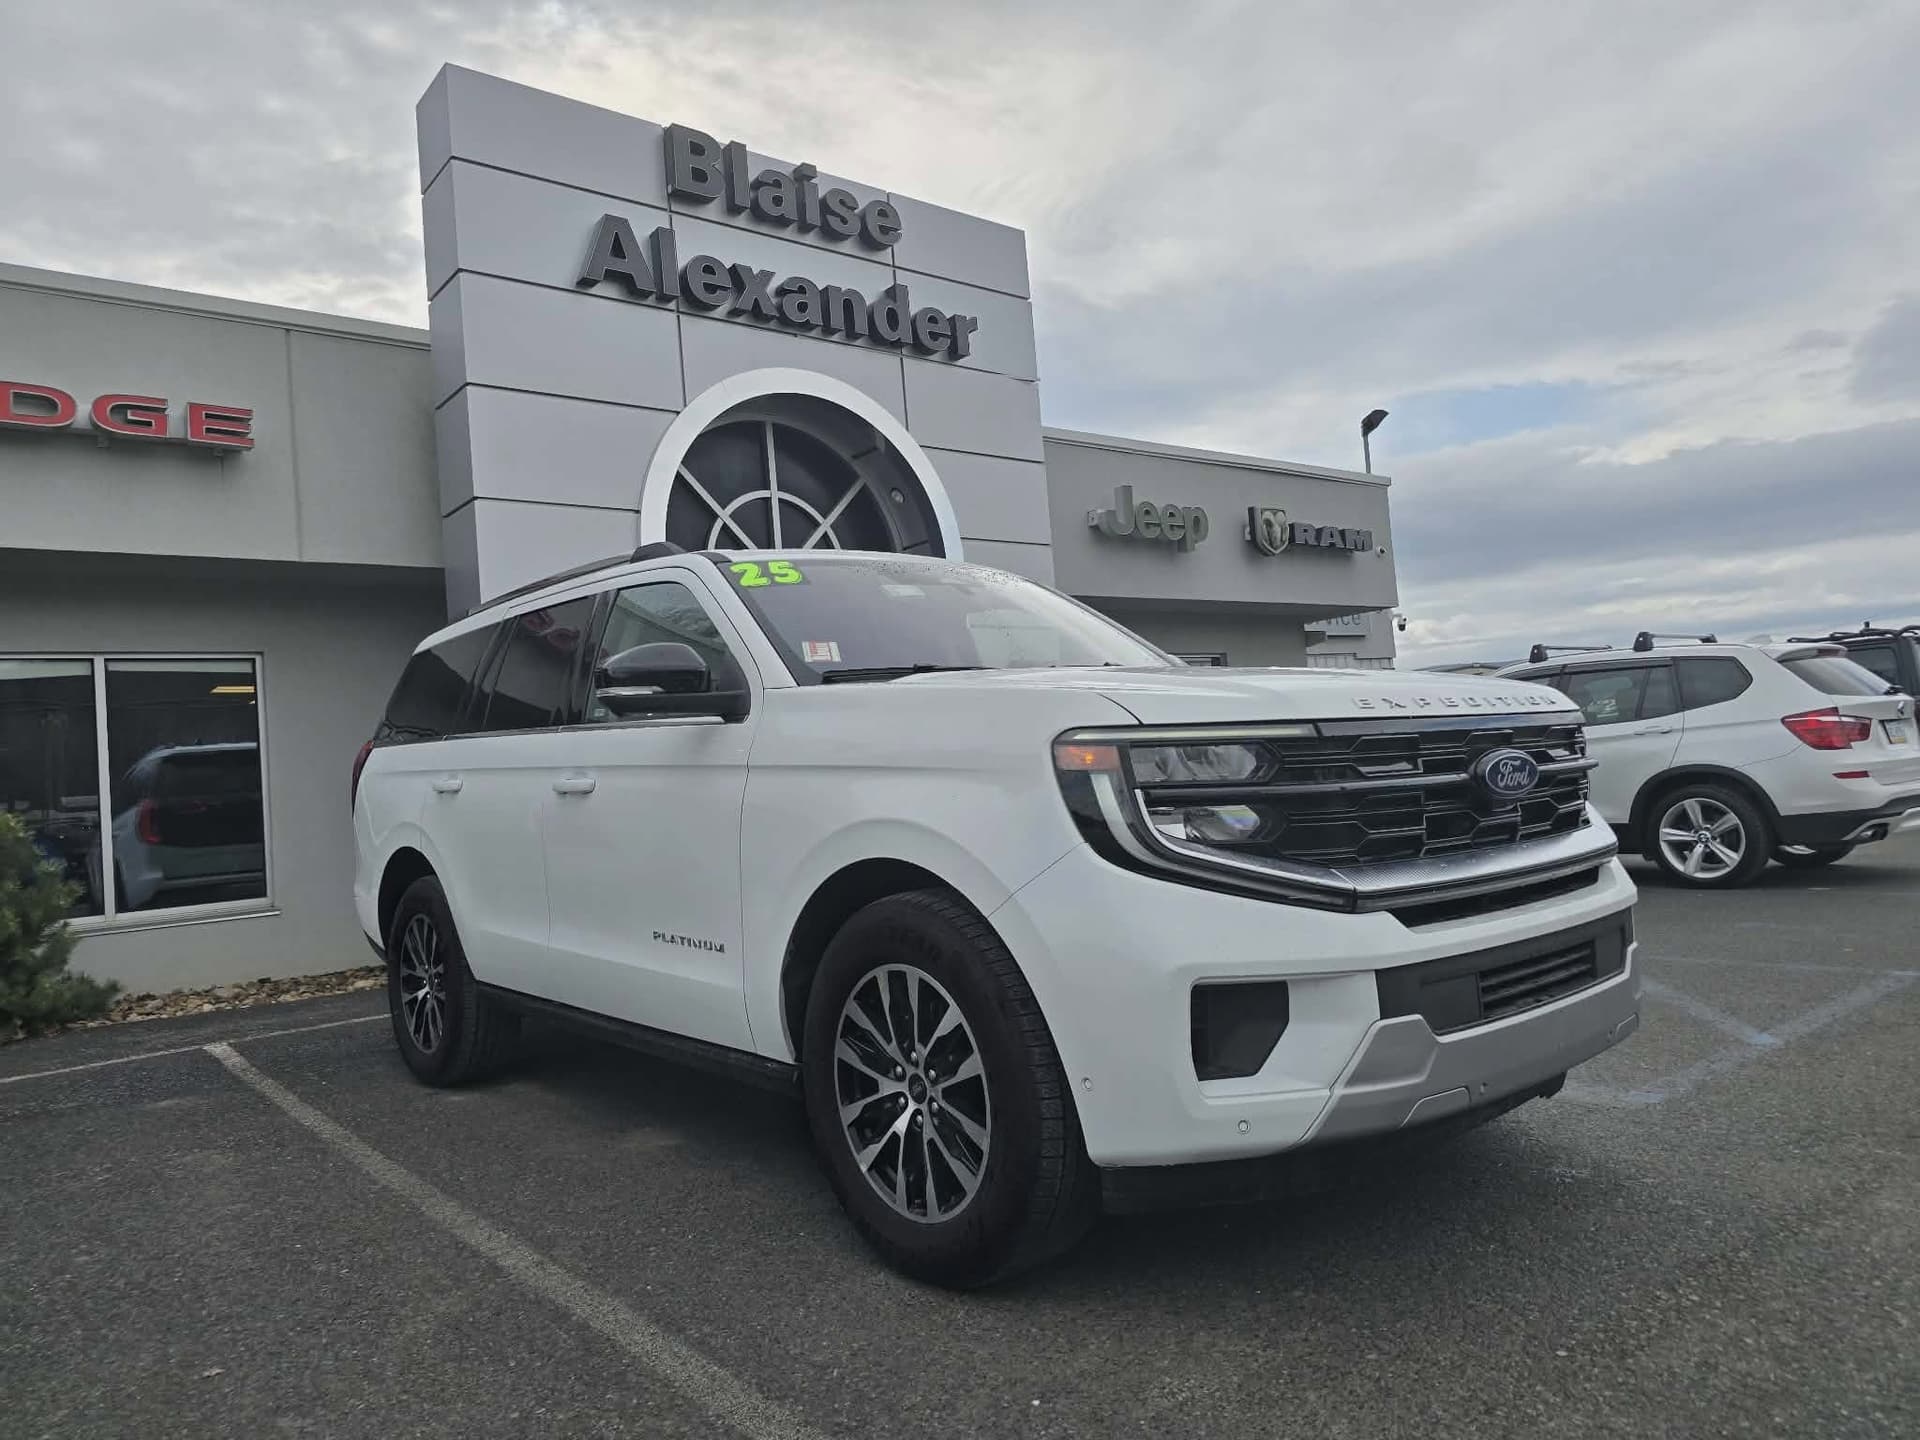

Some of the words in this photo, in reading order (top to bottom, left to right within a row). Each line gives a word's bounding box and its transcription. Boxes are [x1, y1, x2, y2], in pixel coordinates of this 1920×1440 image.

[664, 123, 903, 249] Blaise
[577, 213, 978, 360] Alexander
[1088, 485, 1209, 552] Jeep
[1290, 522, 1373, 551] RAM
[730, 561, 803, 587] 25
[1498, 759, 1530, 788] Ford
[652, 930, 725, 953] PLATINUM
